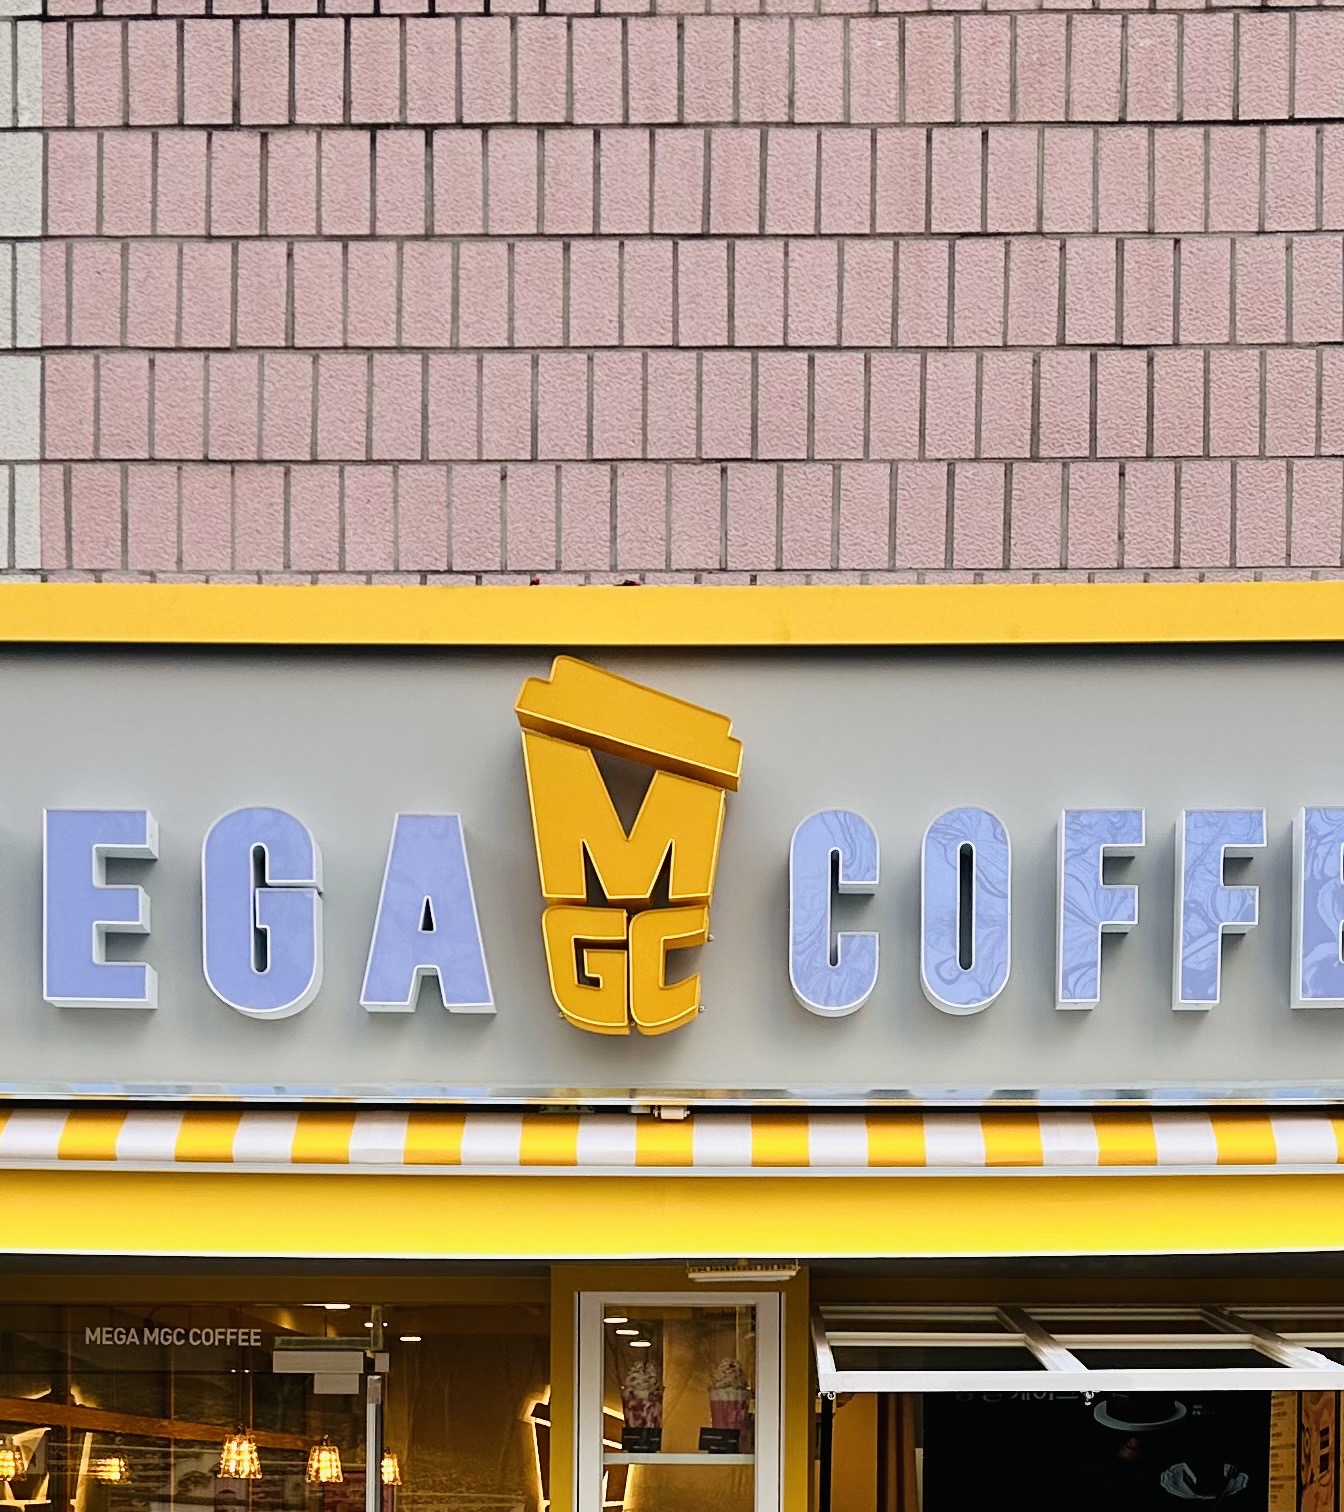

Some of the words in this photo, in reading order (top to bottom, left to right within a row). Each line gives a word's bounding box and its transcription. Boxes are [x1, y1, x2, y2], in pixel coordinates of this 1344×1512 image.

[84, 1326, 142, 1347] MEGA
[144, 1327, 186, 1347] MGC
[188, 1328, 262, 1348] COFFEE
